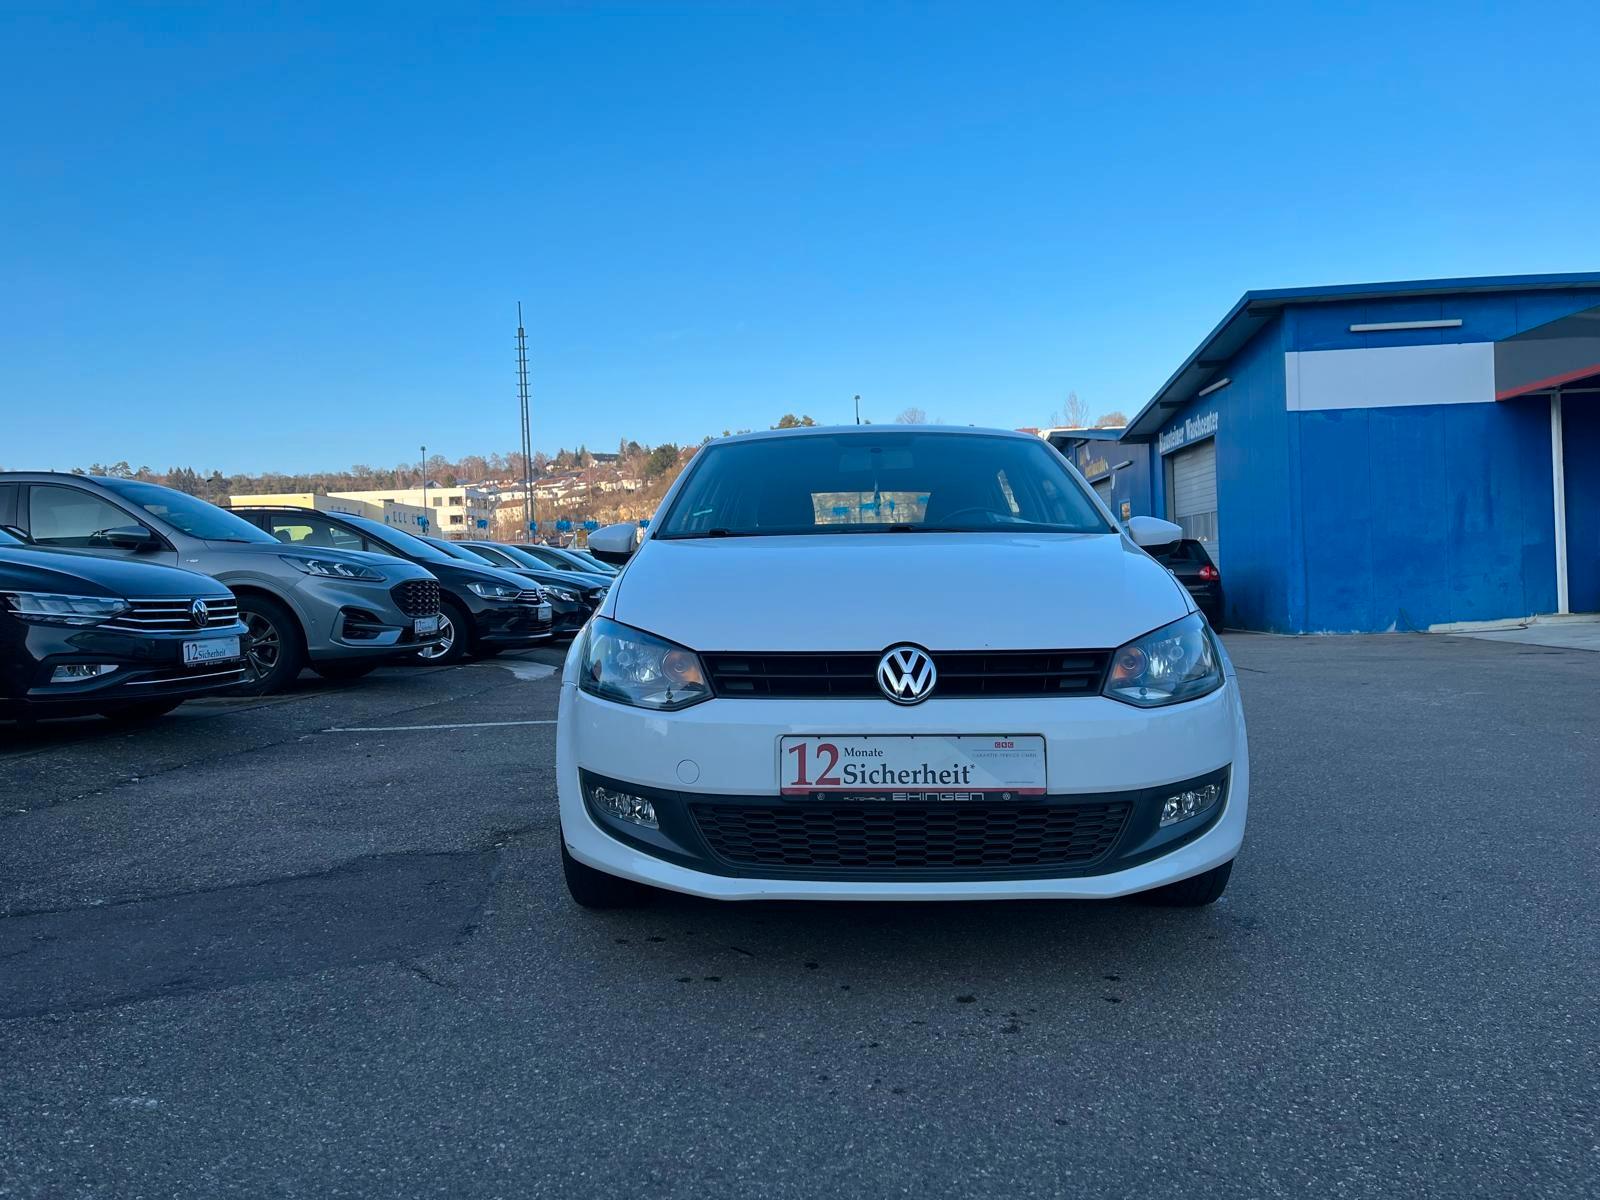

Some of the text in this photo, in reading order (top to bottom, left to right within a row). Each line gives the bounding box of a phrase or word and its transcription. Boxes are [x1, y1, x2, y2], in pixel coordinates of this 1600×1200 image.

[185, 643, 199, 661] 12
[879, 647, 935, 702] VW
[844, 747, 884, 758] Monate
[788, 742, 841, 786] 12
[892, 792, 985, 801] EHINGEN
